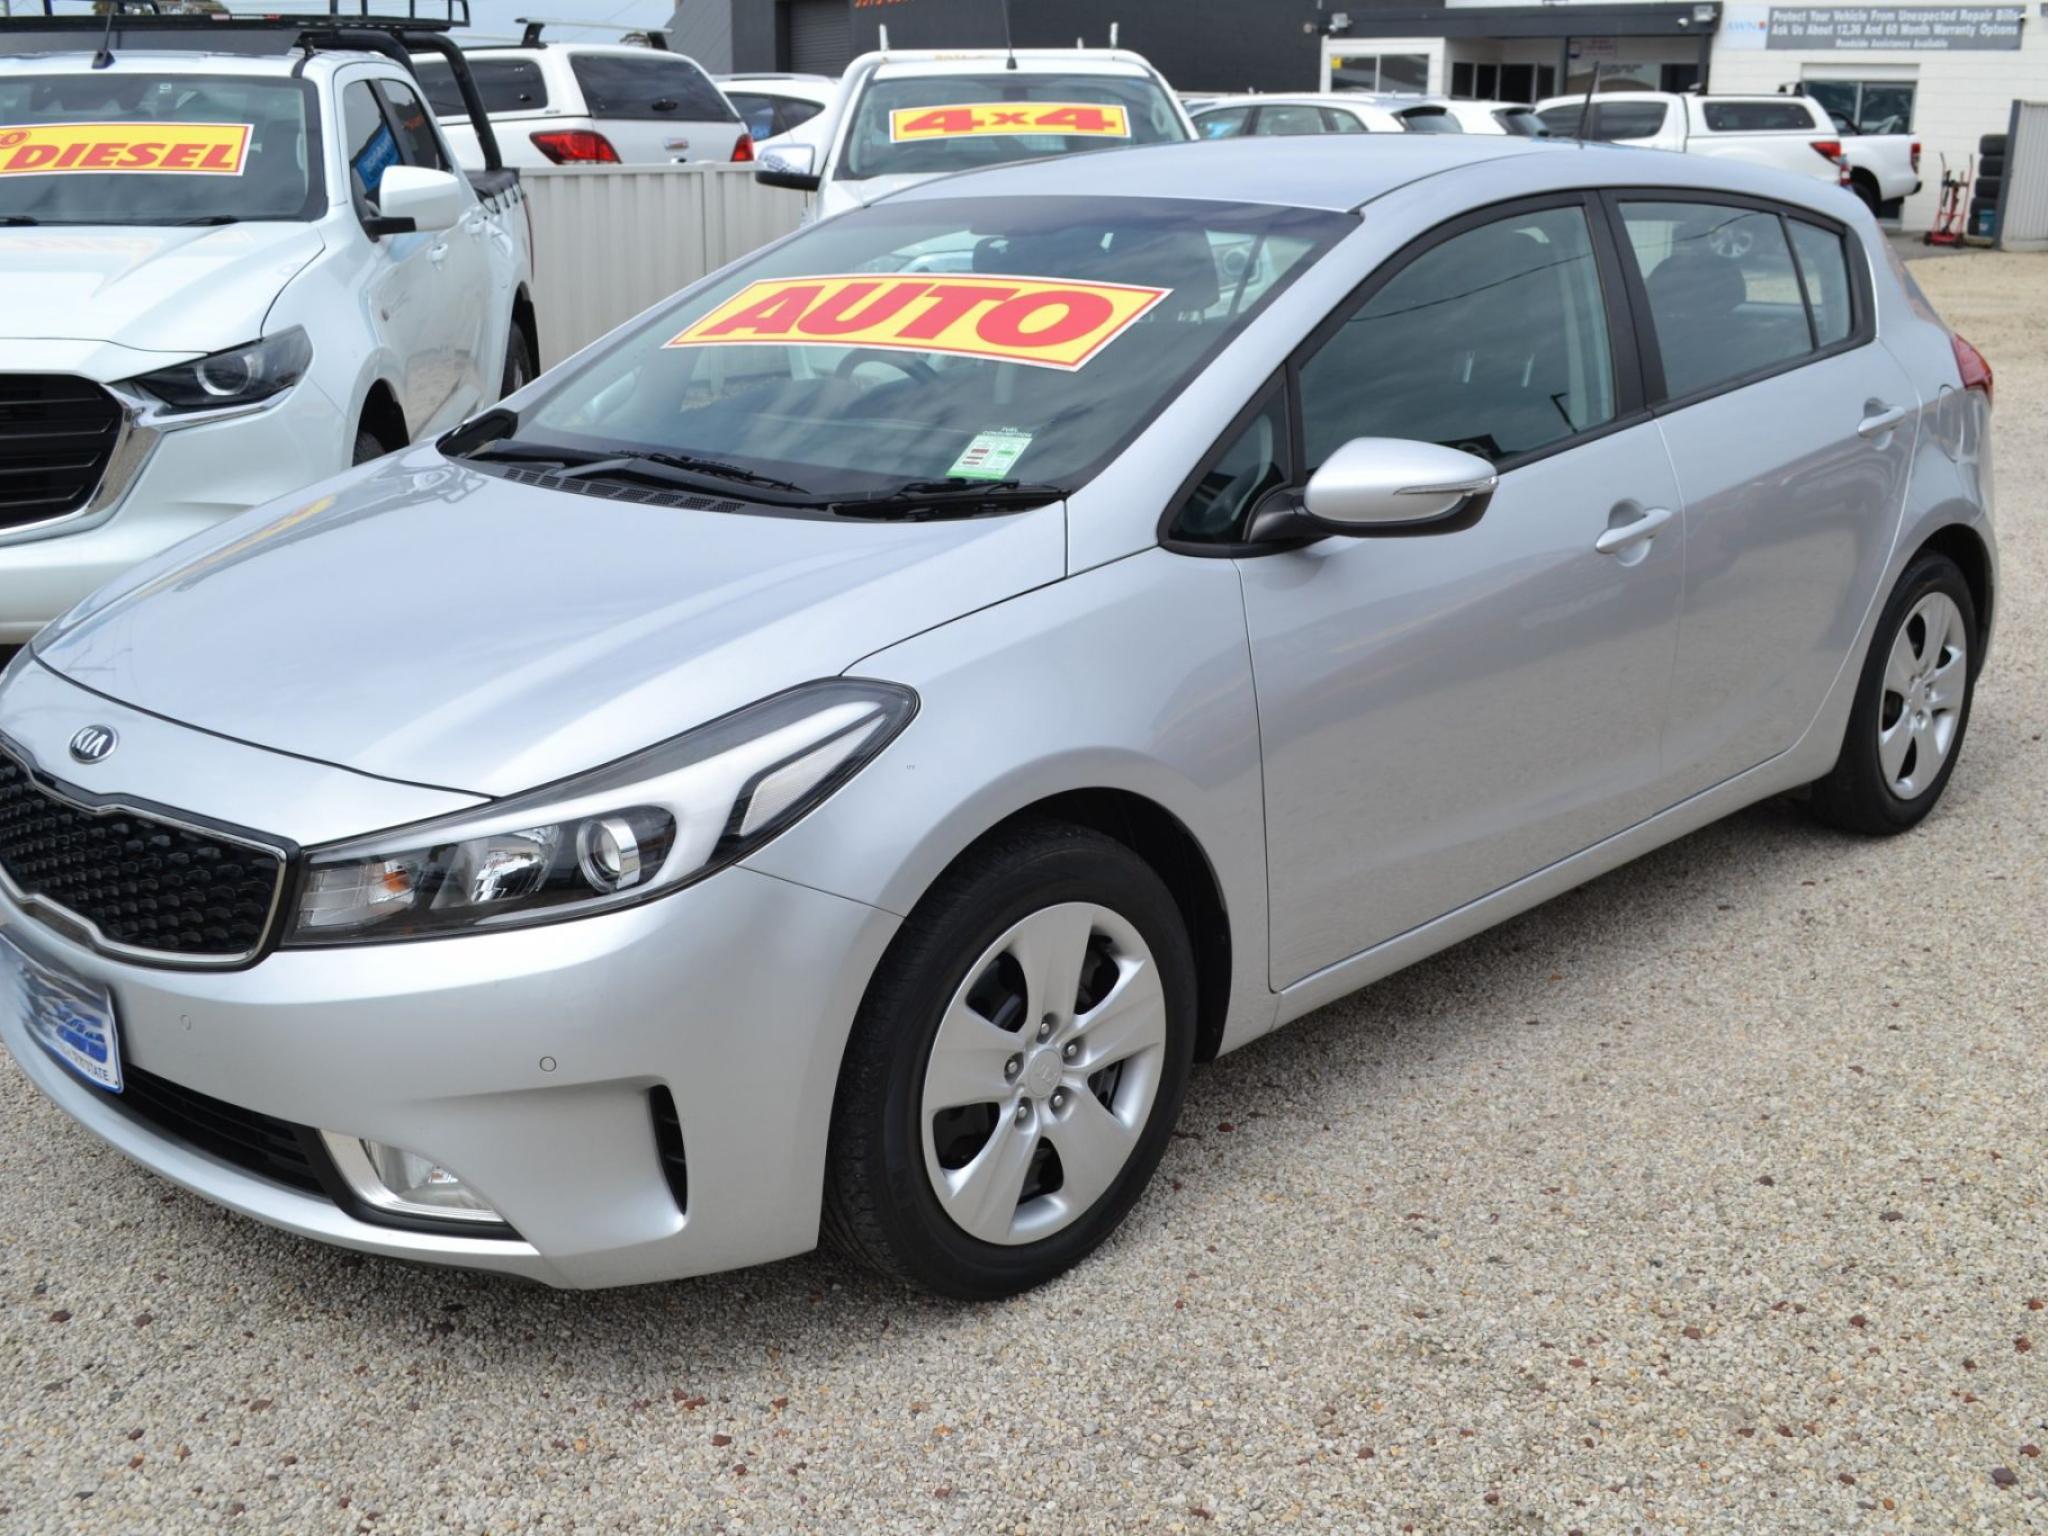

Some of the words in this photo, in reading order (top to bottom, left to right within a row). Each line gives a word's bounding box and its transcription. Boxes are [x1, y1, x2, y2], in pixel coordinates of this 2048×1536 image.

[1772, 10, 1806, 22] Protect
[1810, 10, 1830, 22] Your
[1834, 10, 1867, 22] Vehicle
[1871, 10, 1895, 21] From
[1898, 9, 1957, 23] Unexpected
[1960, 9, 1993, 22] Repair
[1771, 24, 1788, 35] Ask
[1792, 24, 1804, 35] Us
[1806, 24, 1833, 35] About
[1864, 24, 1883, 35] And
[1885, 23, 1898, 35] 60
[1900, 23, 1930, 35] Month
[1933, 23, 1977, 38] Warranty
[1980, 23, 2018, 37] Options
[903, 108, 1116, 132] 4x4
[4, 143, 233, 170] DIESEL
[697, 283, 1114, 347] AUTO
